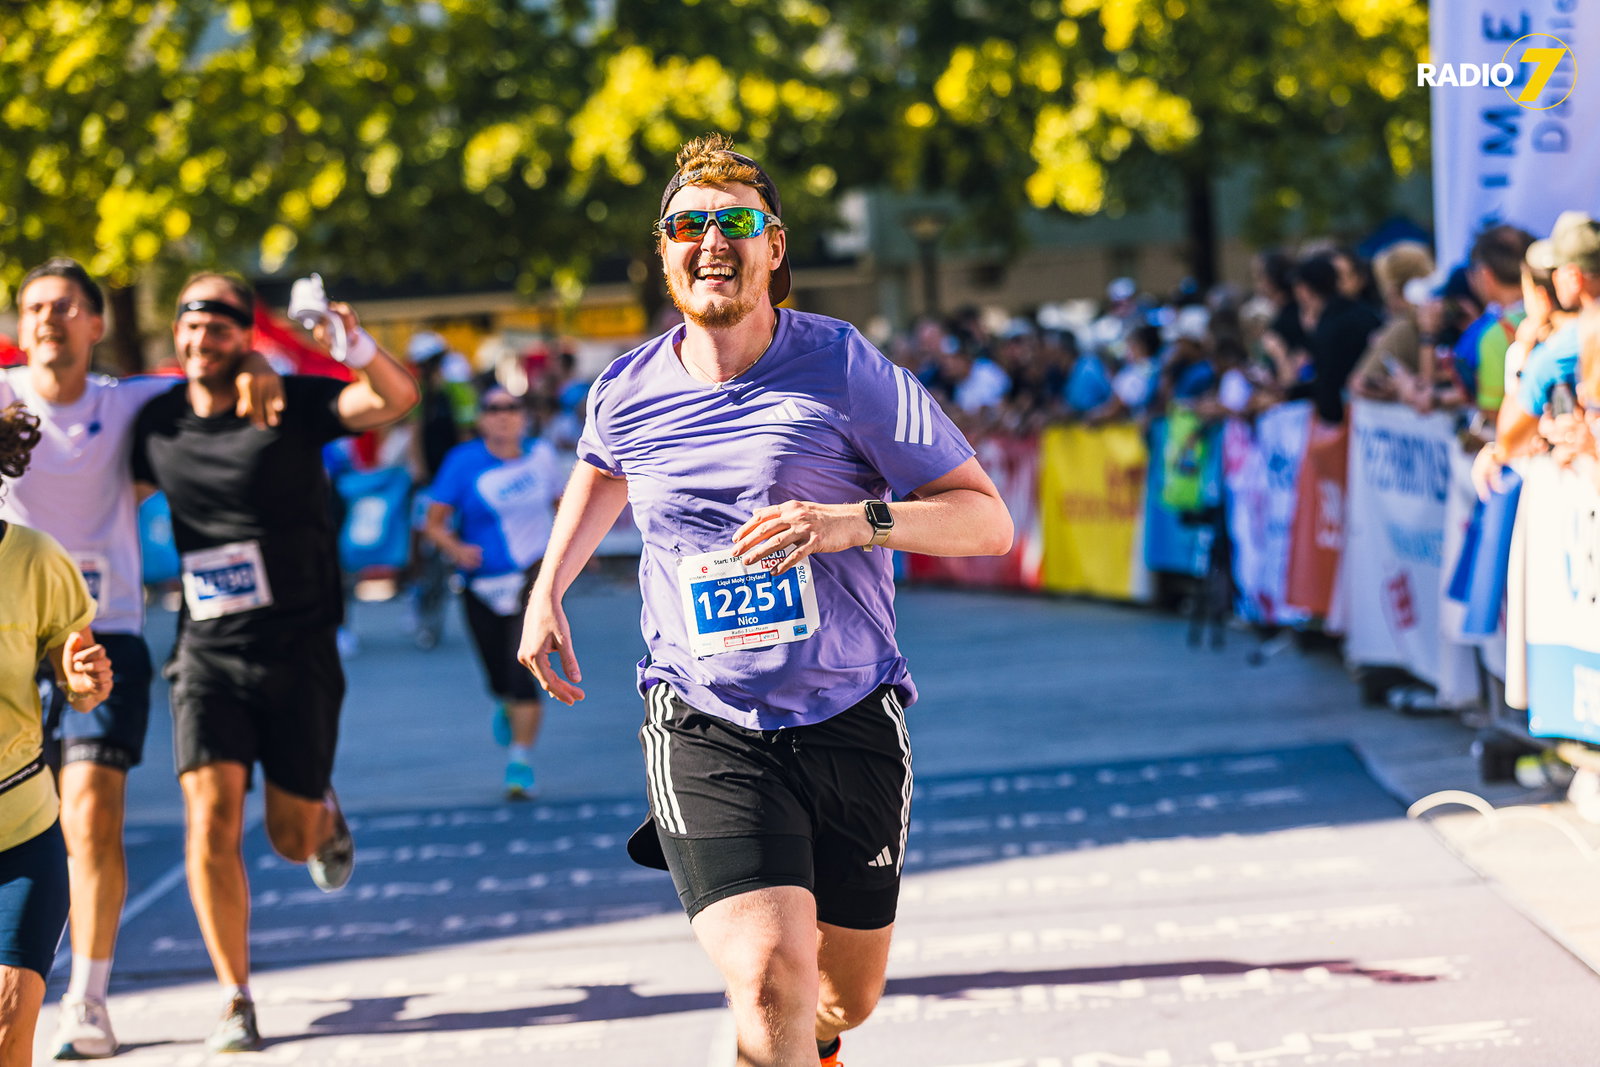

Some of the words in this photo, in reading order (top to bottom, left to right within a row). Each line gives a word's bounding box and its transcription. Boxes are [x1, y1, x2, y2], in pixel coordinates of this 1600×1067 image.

[798, 565, 807, 584] 2026
[717, 579, 731, 587] Liqui
[731, 577, 745, 585] Moly
[697, 579, 793, 621] 12251
[737, 616, 759, 626] Nico
